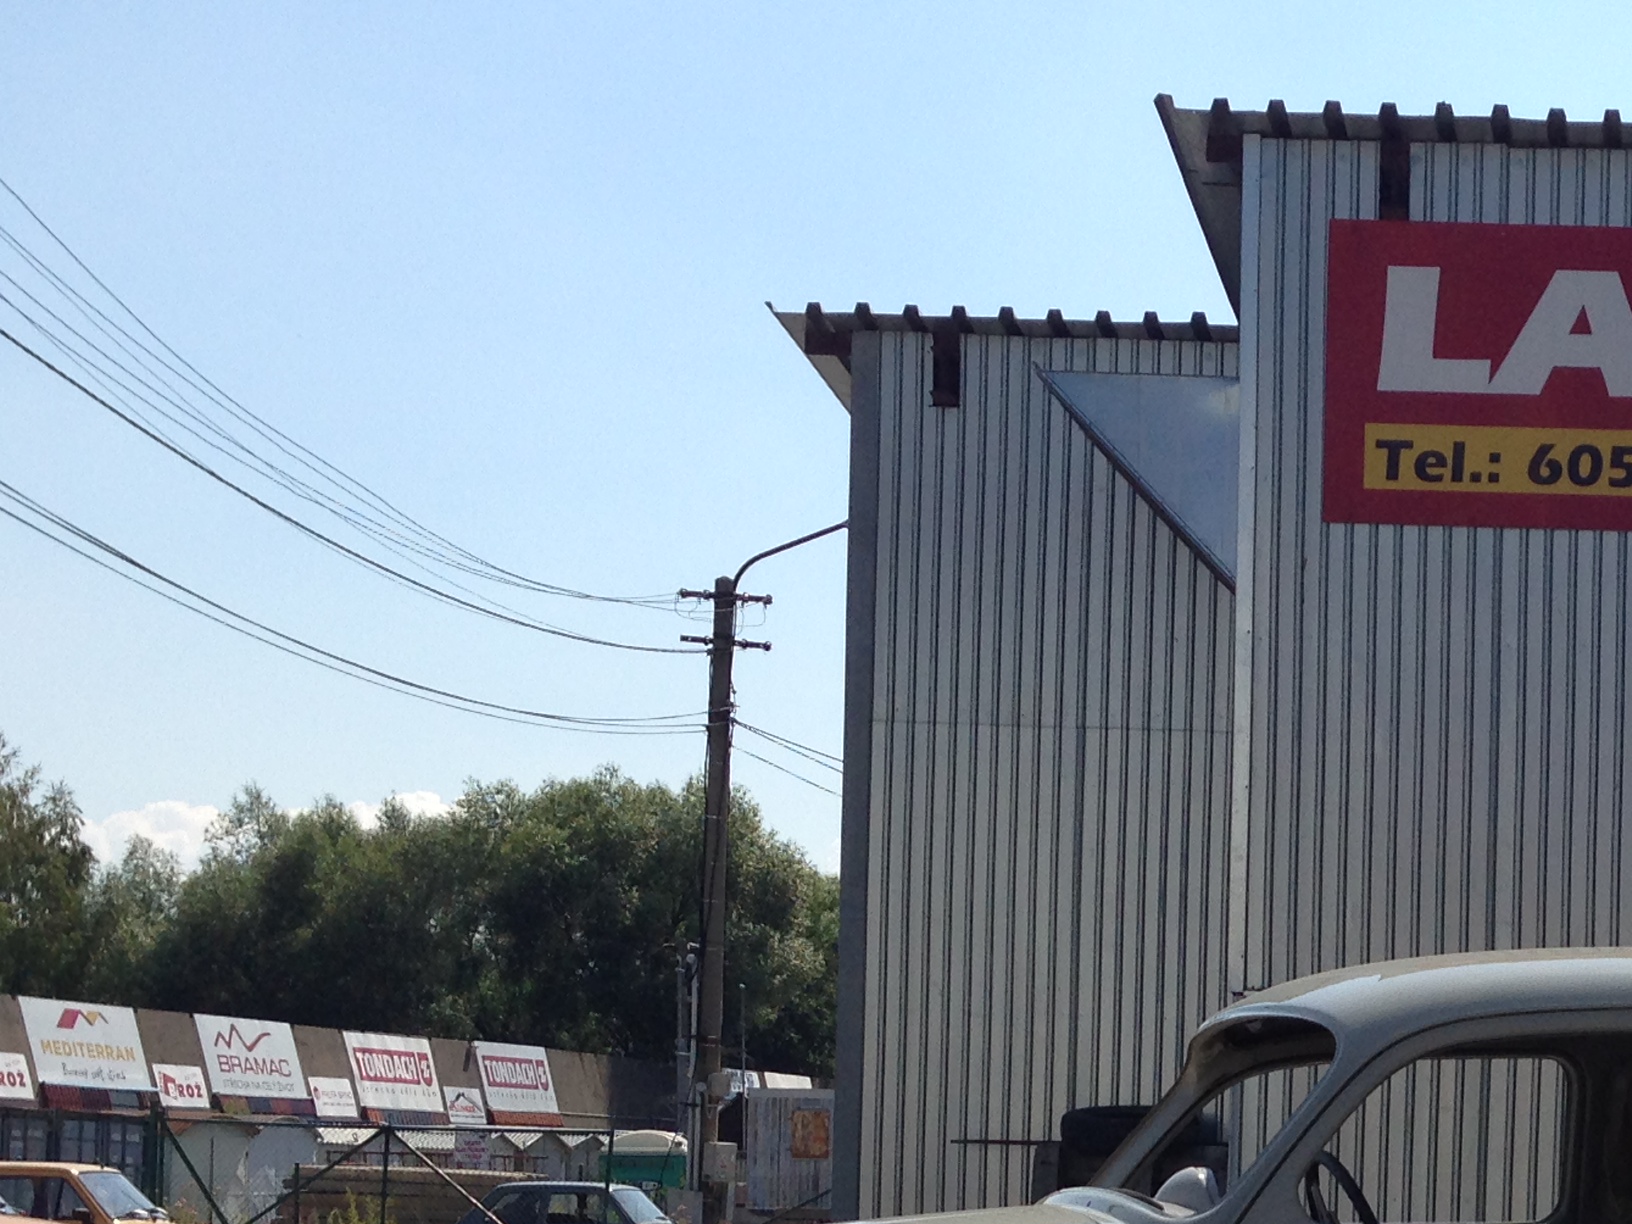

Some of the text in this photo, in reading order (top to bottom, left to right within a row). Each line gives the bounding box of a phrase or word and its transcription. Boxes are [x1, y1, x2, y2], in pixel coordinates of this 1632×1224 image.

[1375, 438, 1500, 483] Tel.:
[41, 1039, 136, 1061] MEDITERRAN
[216, 1054, 292, 1077] BRAMAC
[355, 1051, 418, 1081] TONDACH
[484, 1060, 537, 1087] TONDACH
